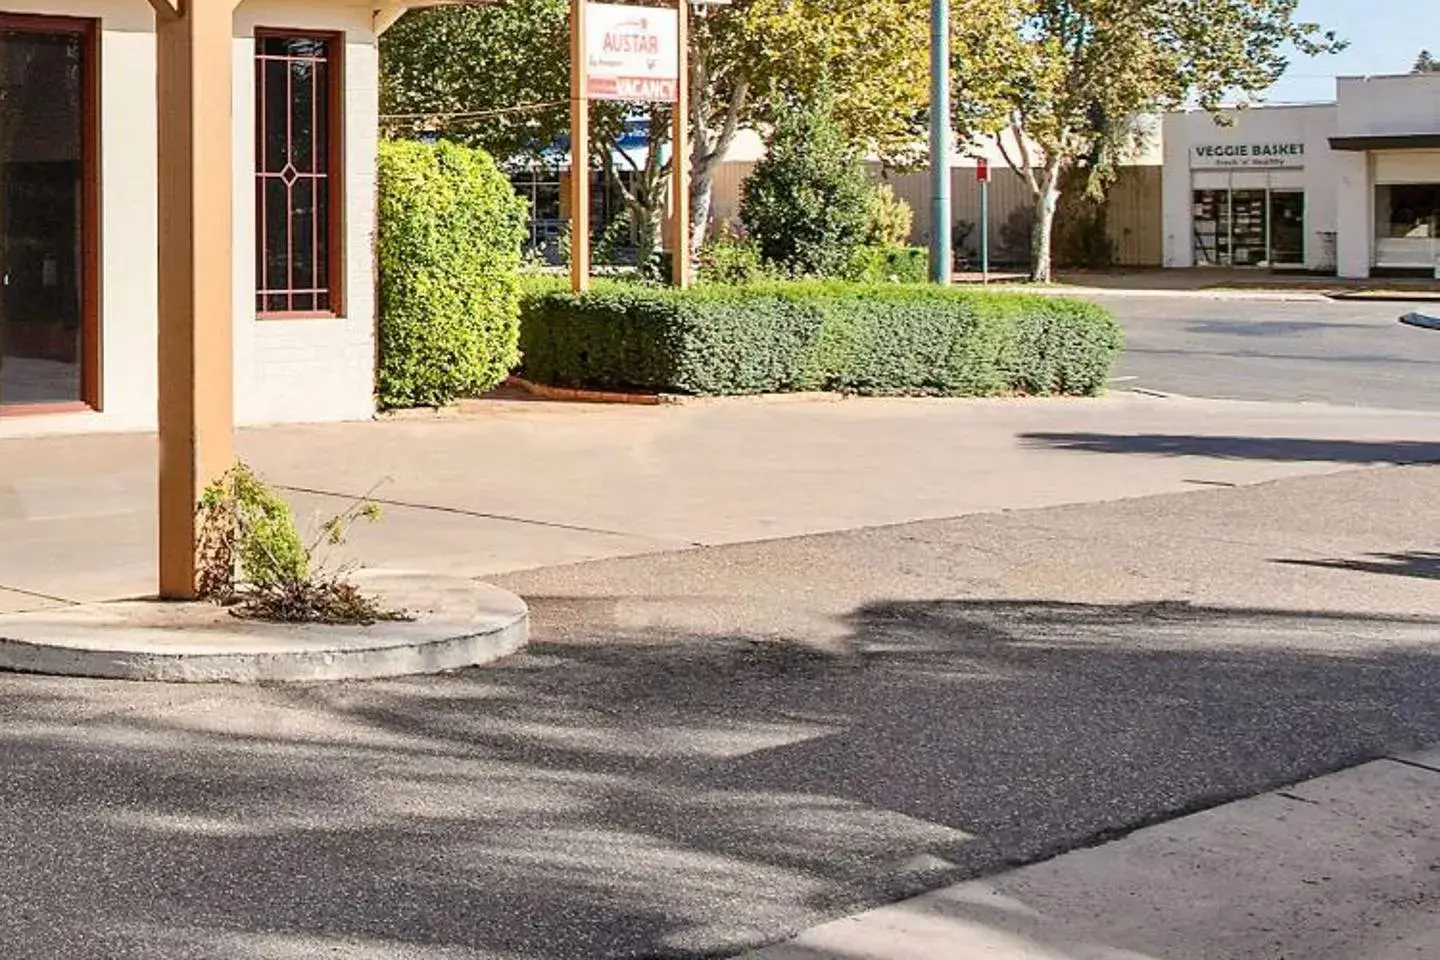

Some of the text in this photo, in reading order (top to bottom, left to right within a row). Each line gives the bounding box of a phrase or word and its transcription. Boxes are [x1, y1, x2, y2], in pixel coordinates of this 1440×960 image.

[603, 31, 658, 53] AUSTAR
[618, 78, 675, 100] VACANCY
[1196, 143, 1305, 157] VEGGIE BASKET
